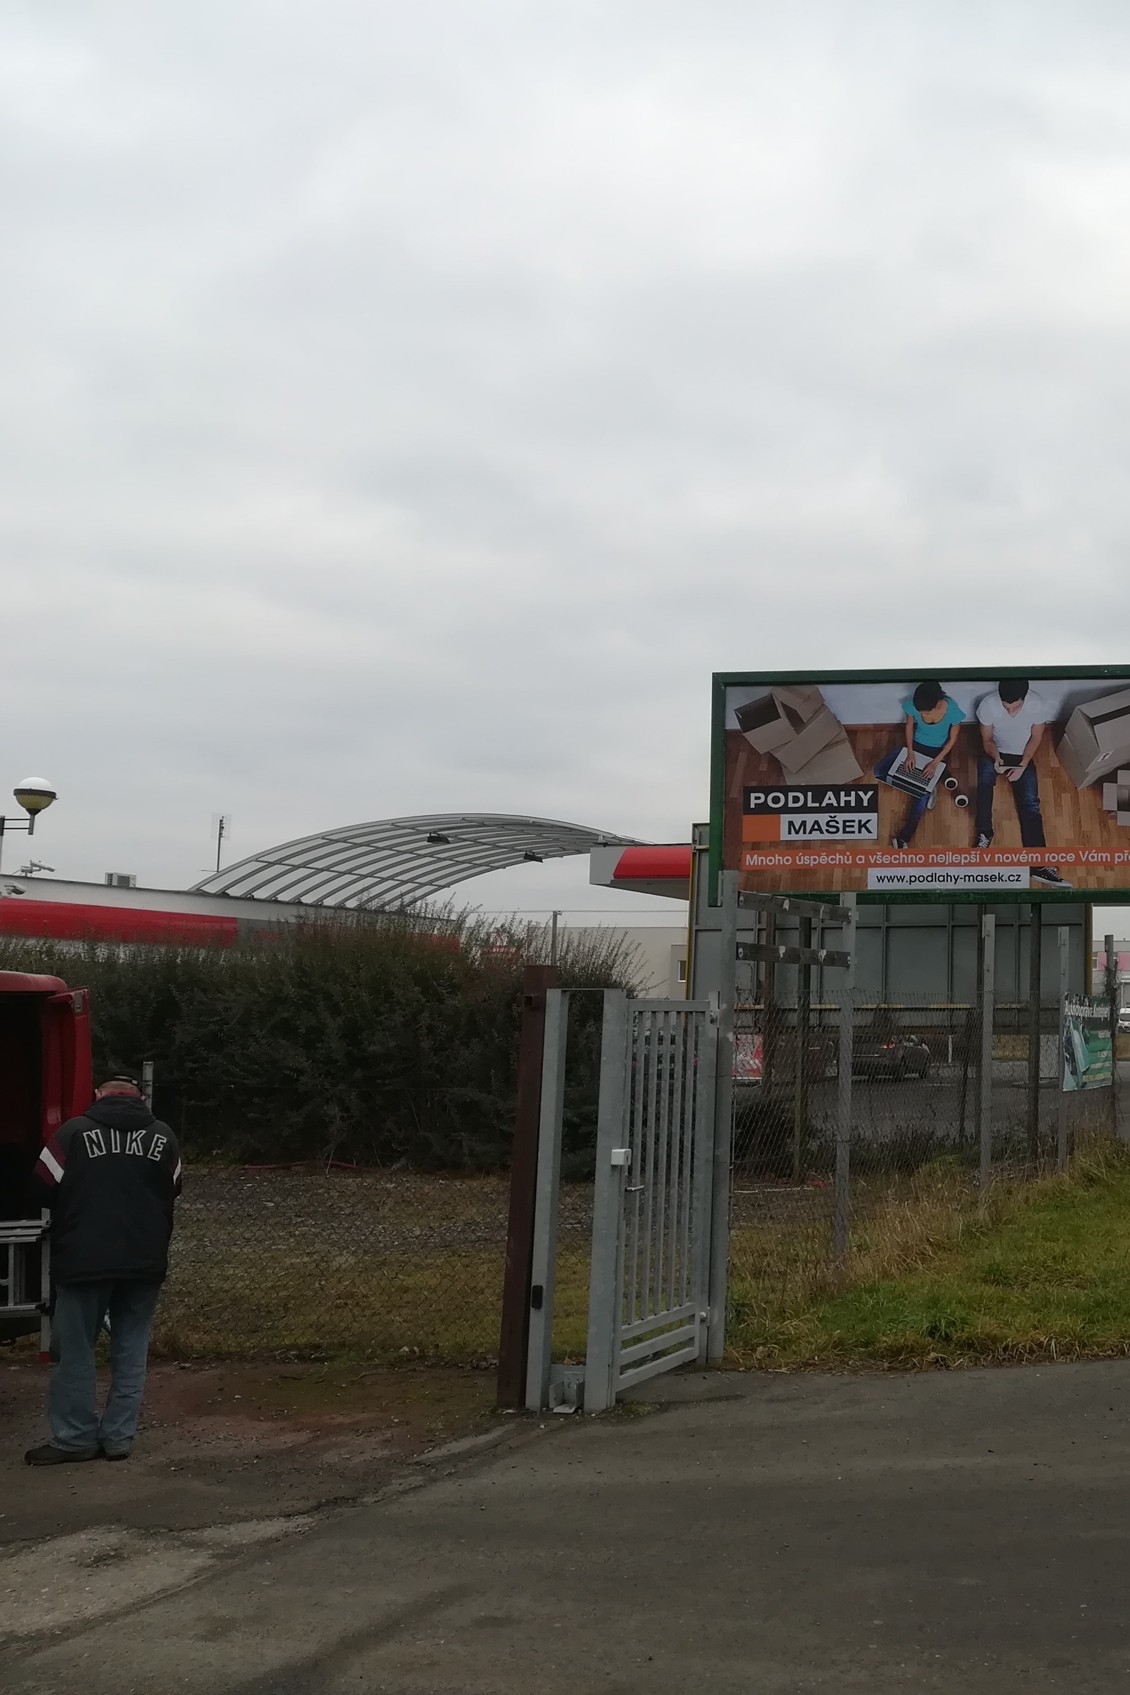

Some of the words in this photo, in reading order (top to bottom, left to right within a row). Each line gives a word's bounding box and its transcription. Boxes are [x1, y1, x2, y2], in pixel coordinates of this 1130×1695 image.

[749, 790, 875, 809] PODLAHY
[787, 815, 874, 835] MAŠEK
[745, 853, 792, 866] Mnoho
[796, 851, 853, 867] úspěchů
[856, 855, 865, 864] a
[869, 852, 925, 864] všechno
[929, 851, 980, 865] nejlepší
[983, 853, 991, 862] v
[994, 851, 1042, 862] novém
[1045, 853, 1075, 862] roce
[1079, 850, 1110, 861] Vám
[876, 872, 1022, 886] www.podlahy-masek.cz
[83, 1128, 167, 1161] NIKE
